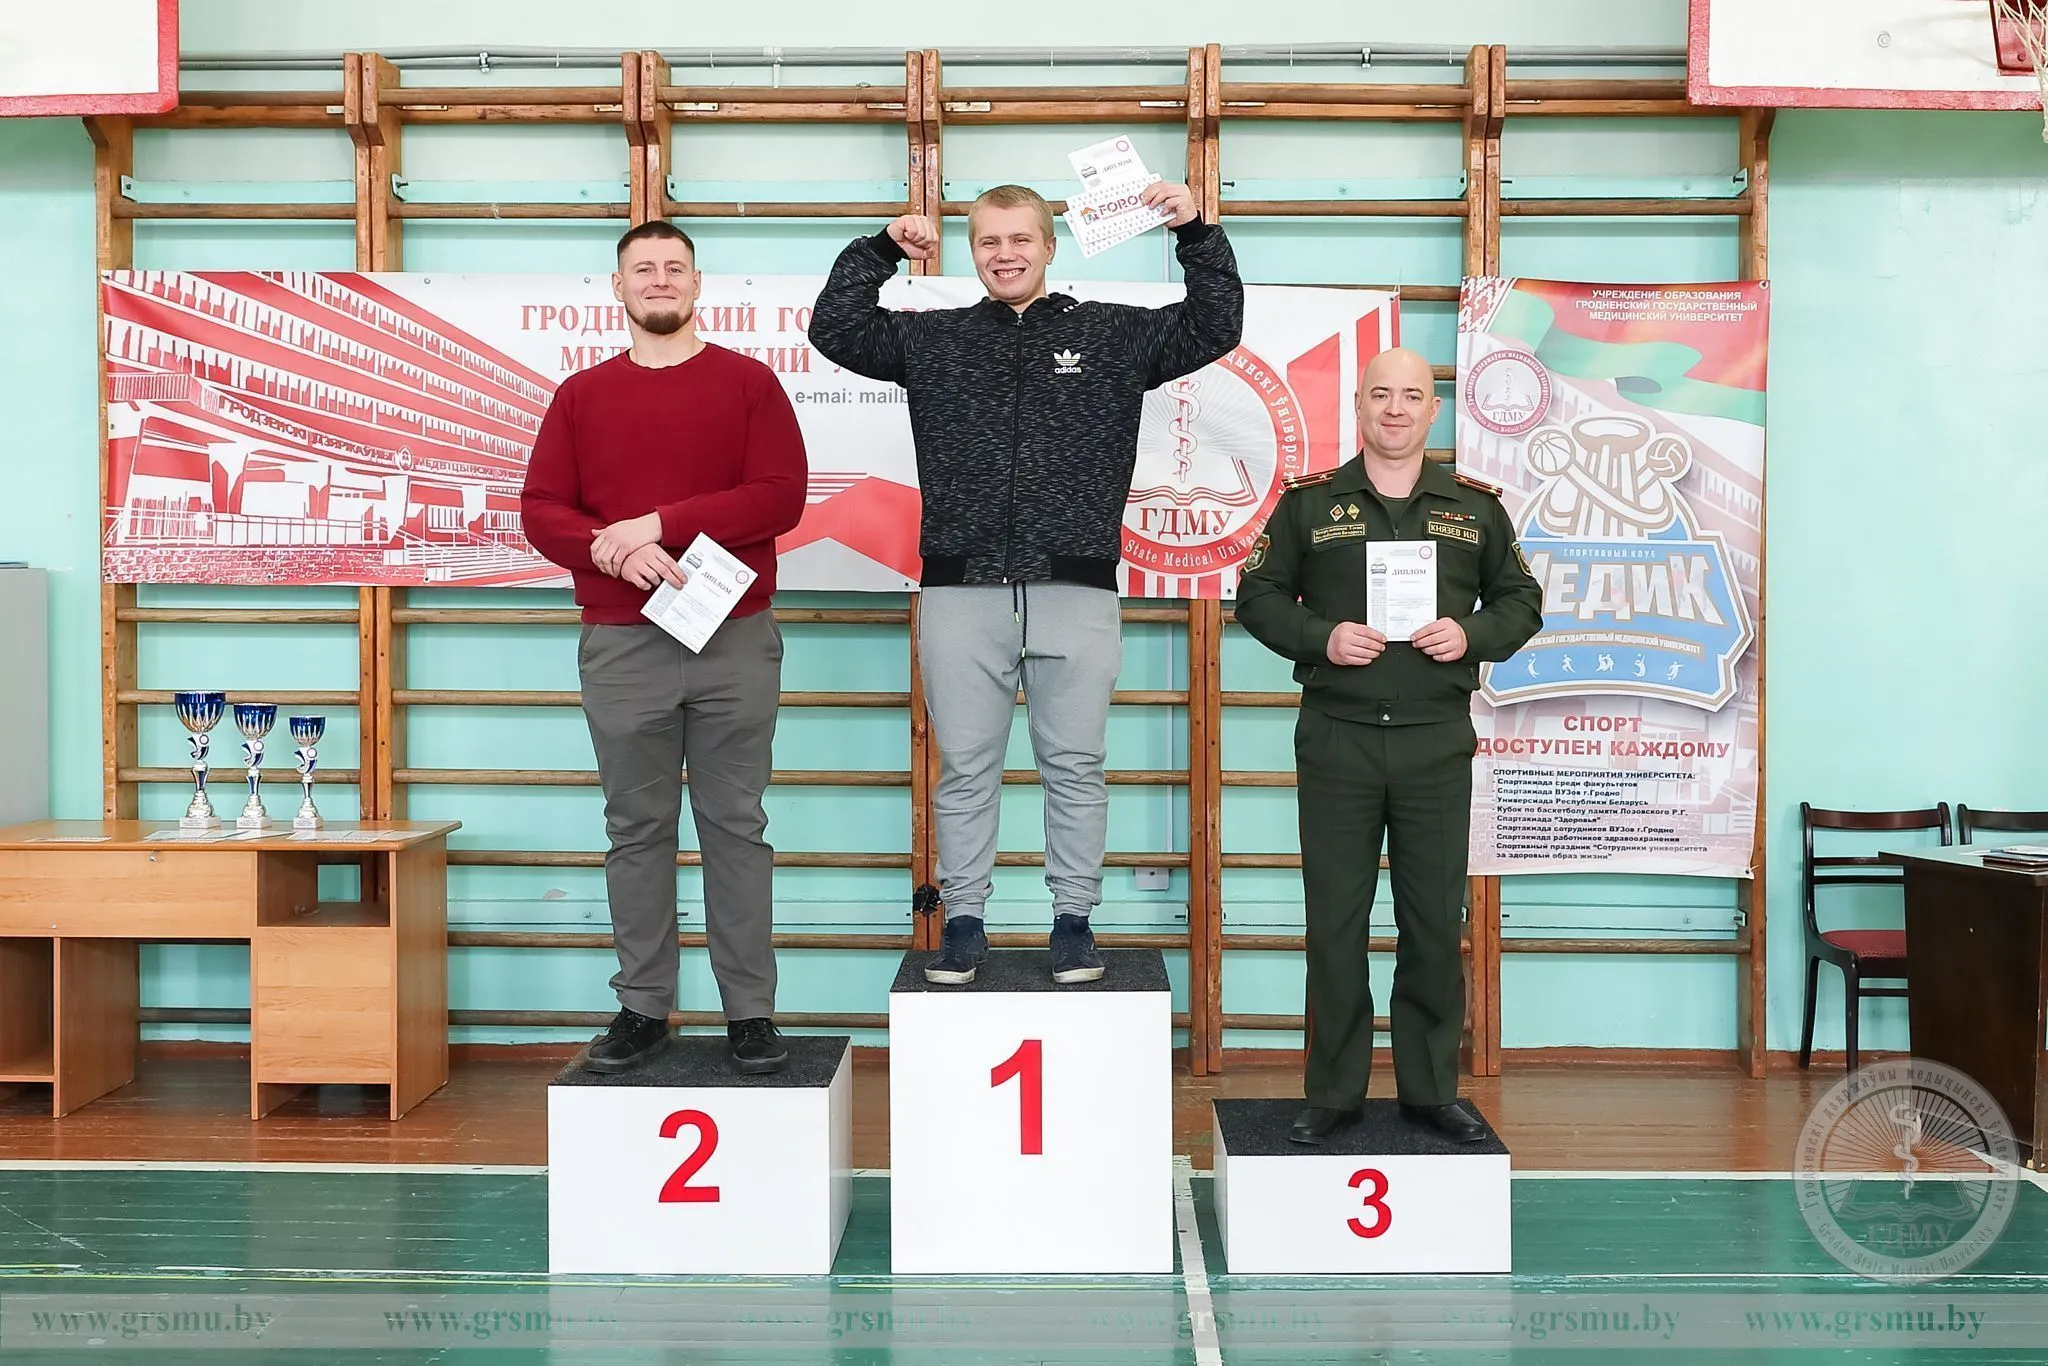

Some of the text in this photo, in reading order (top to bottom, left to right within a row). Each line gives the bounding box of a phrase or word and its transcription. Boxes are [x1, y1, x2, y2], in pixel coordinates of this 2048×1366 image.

[1592, 290, 1741, 300] УЧРЕЖДЕНИЕ ОБРАЗОВАНИЯ
[1575, 300, 1757, 311] ГРОДНЕНСКИЙ ГОСУДАРСТВЕННЫЙ
[521, 302, 757, 337] ГРОДНКИЙ
[1589, 311, 1743, 322] МЕДИЦИНСКИЙ УНИВЕРСИТЕТ
[1055, 366, 1082, 374] adidas
[795, 388, 908, 404] e-mai: mailb
[1139, 507, 1234, 542] ГДМУ
[1125, 539, 1158, 563] State
[1164, 550, 1214, 568] Medical
[1564, 548, 1656, 559] СПОРТИВНЫЙ КЛУБ
[1391, 567, 1427, 576] ДИПЛОМ
[1563, 716, 1643, 732] СПОРТ
[1475, 737, 1730, 759] ДОСТУПЕН КАЖДОМУ
[1493, 769, 1695, 780] СПОРТИВНЫЕ МЕРОПРИЯТИЯ УНИВЕРСИТЕТА:
[1497, 778, 1553, 786] Спартакиада
[1584, 780, 1637, 788] факультетов
[1497, 787, 1620, 797] Спартакиада ВУЗов г.Гродно
[1497, 796, 1648, 807] Универсиада Республики Беларусь
[1537, 806, 1586, 815] баскетболу
[1496, 815, 1552, 823] Спартакиада
[1496, 824, 1551, 832] Спартакиада
[1637, 826, 1674, 834] г.Гродно
[1496, 833, 1551, 841] Спартакиада
[1605, 835, 1680, 843] здравоохранения
[1496, 842, 1548, 850] Спортивный
[1649, 845, 1708, 853] университета
[1552, 852, 1578, 860] образ
[991, 1039, 1043, 1155] 1
[658, 1109, 720, 1203] 2
[1347, 1168, 1392, 1239] 3
